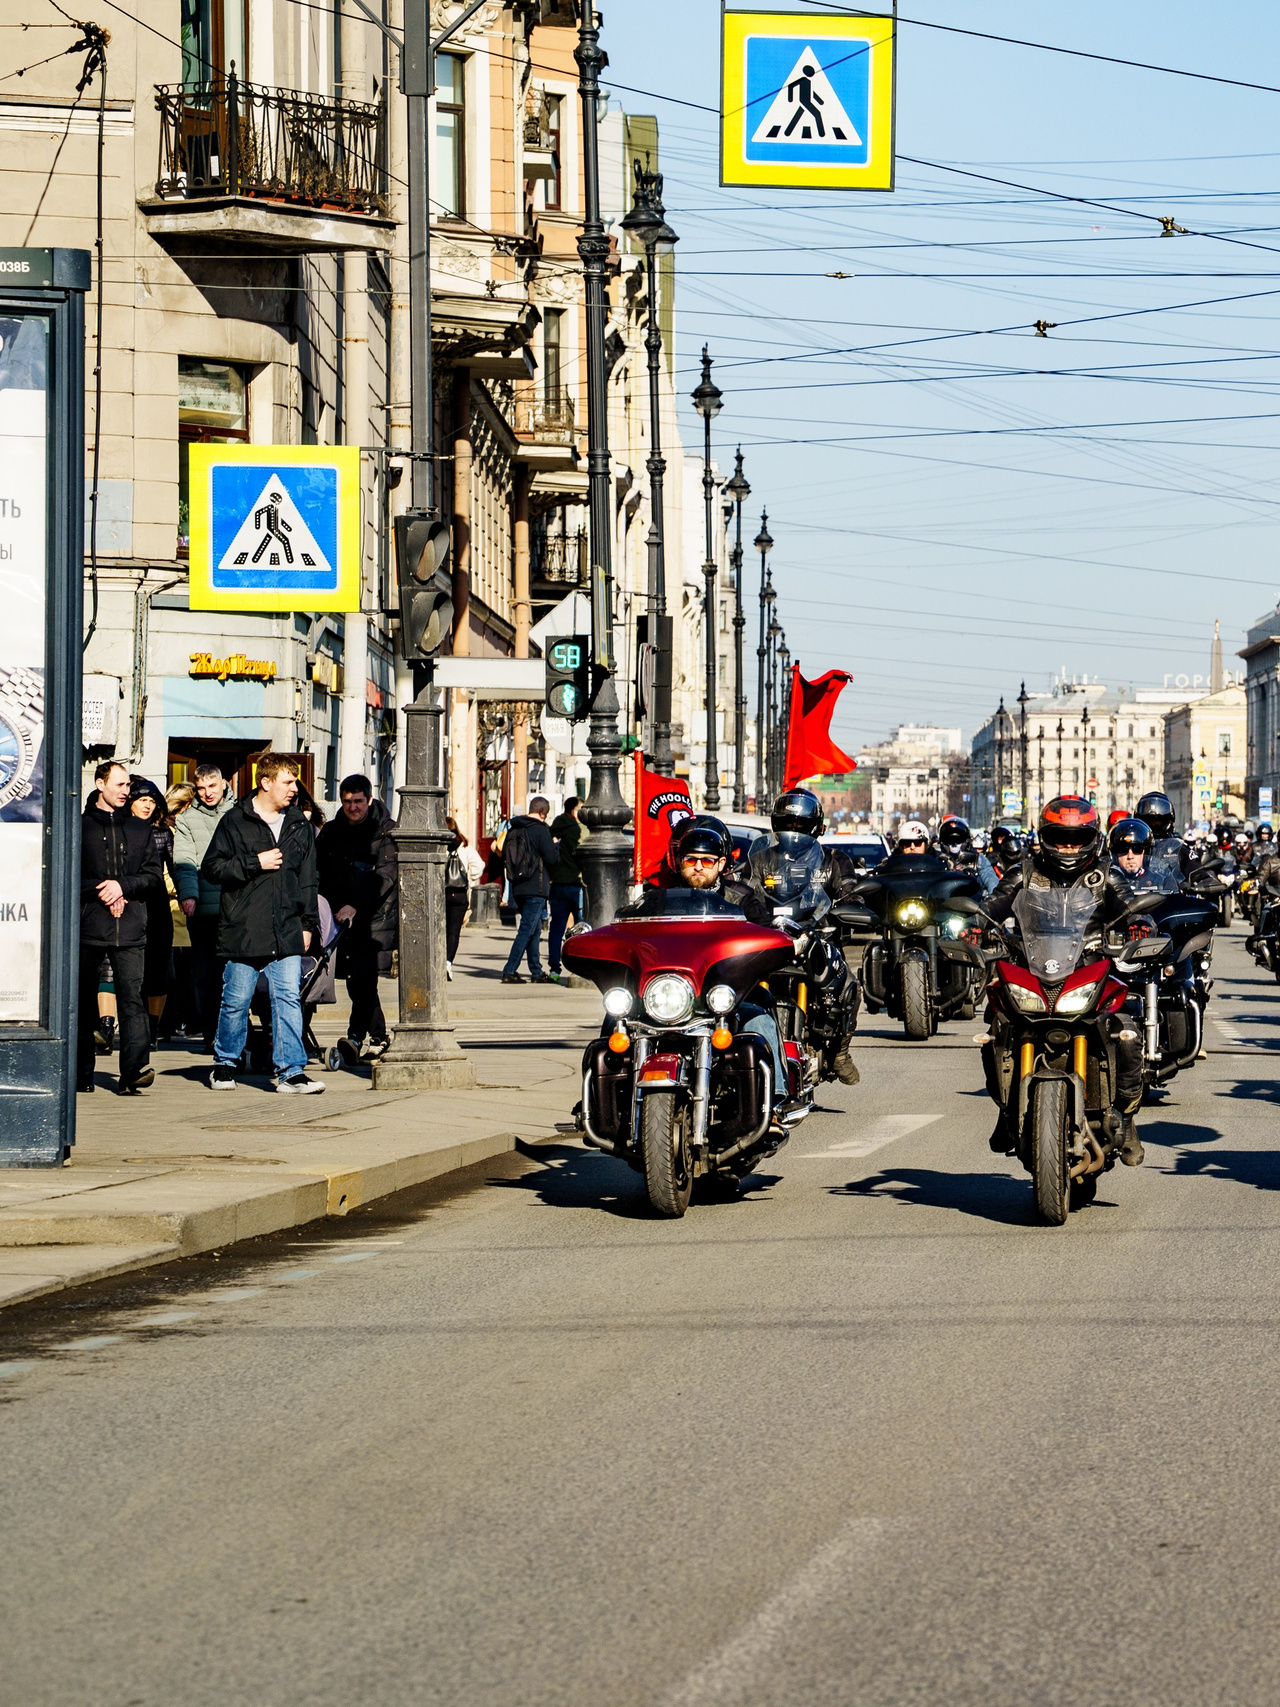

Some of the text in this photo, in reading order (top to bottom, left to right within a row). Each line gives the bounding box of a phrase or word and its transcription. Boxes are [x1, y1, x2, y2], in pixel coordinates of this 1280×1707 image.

[189, 652, 277, 680] Жар Птица
[554, 645, 580, 668] 58
[650, 798, 662, 815] THE
